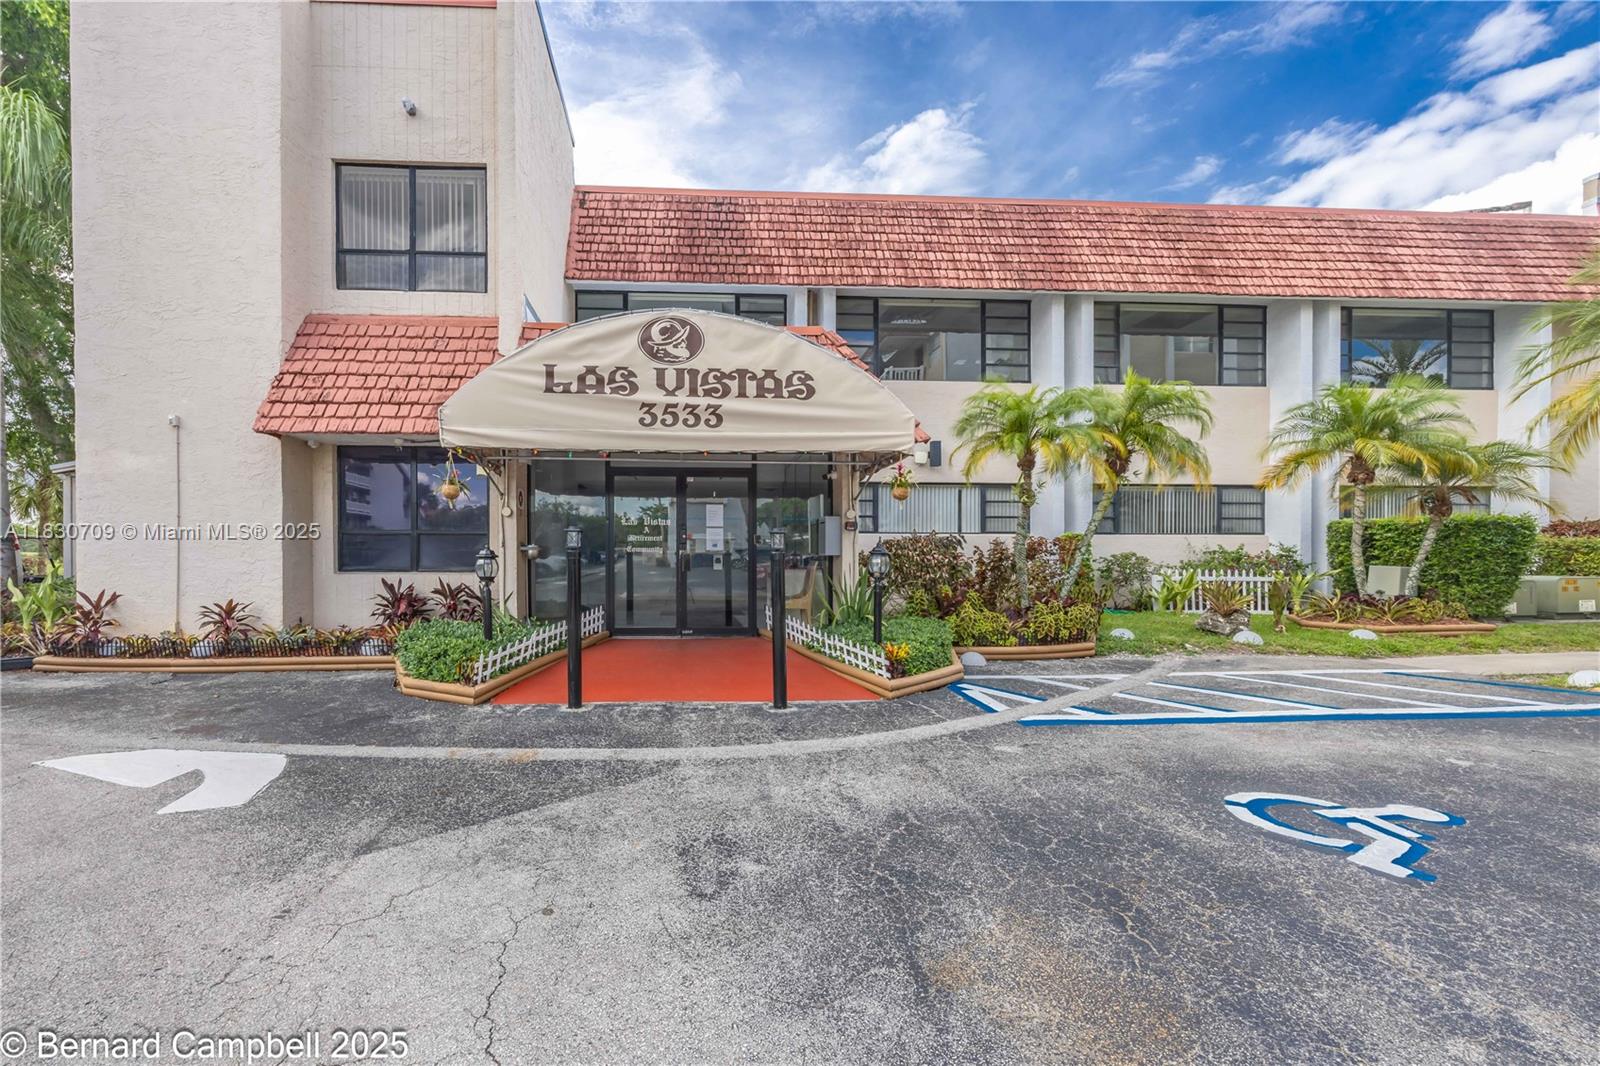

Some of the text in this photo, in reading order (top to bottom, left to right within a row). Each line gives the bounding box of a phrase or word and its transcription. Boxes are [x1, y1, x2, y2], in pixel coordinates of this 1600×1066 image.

[543, 363, 817, 400] LAS VISTAS
[638, 402, 724, 429] 3533
